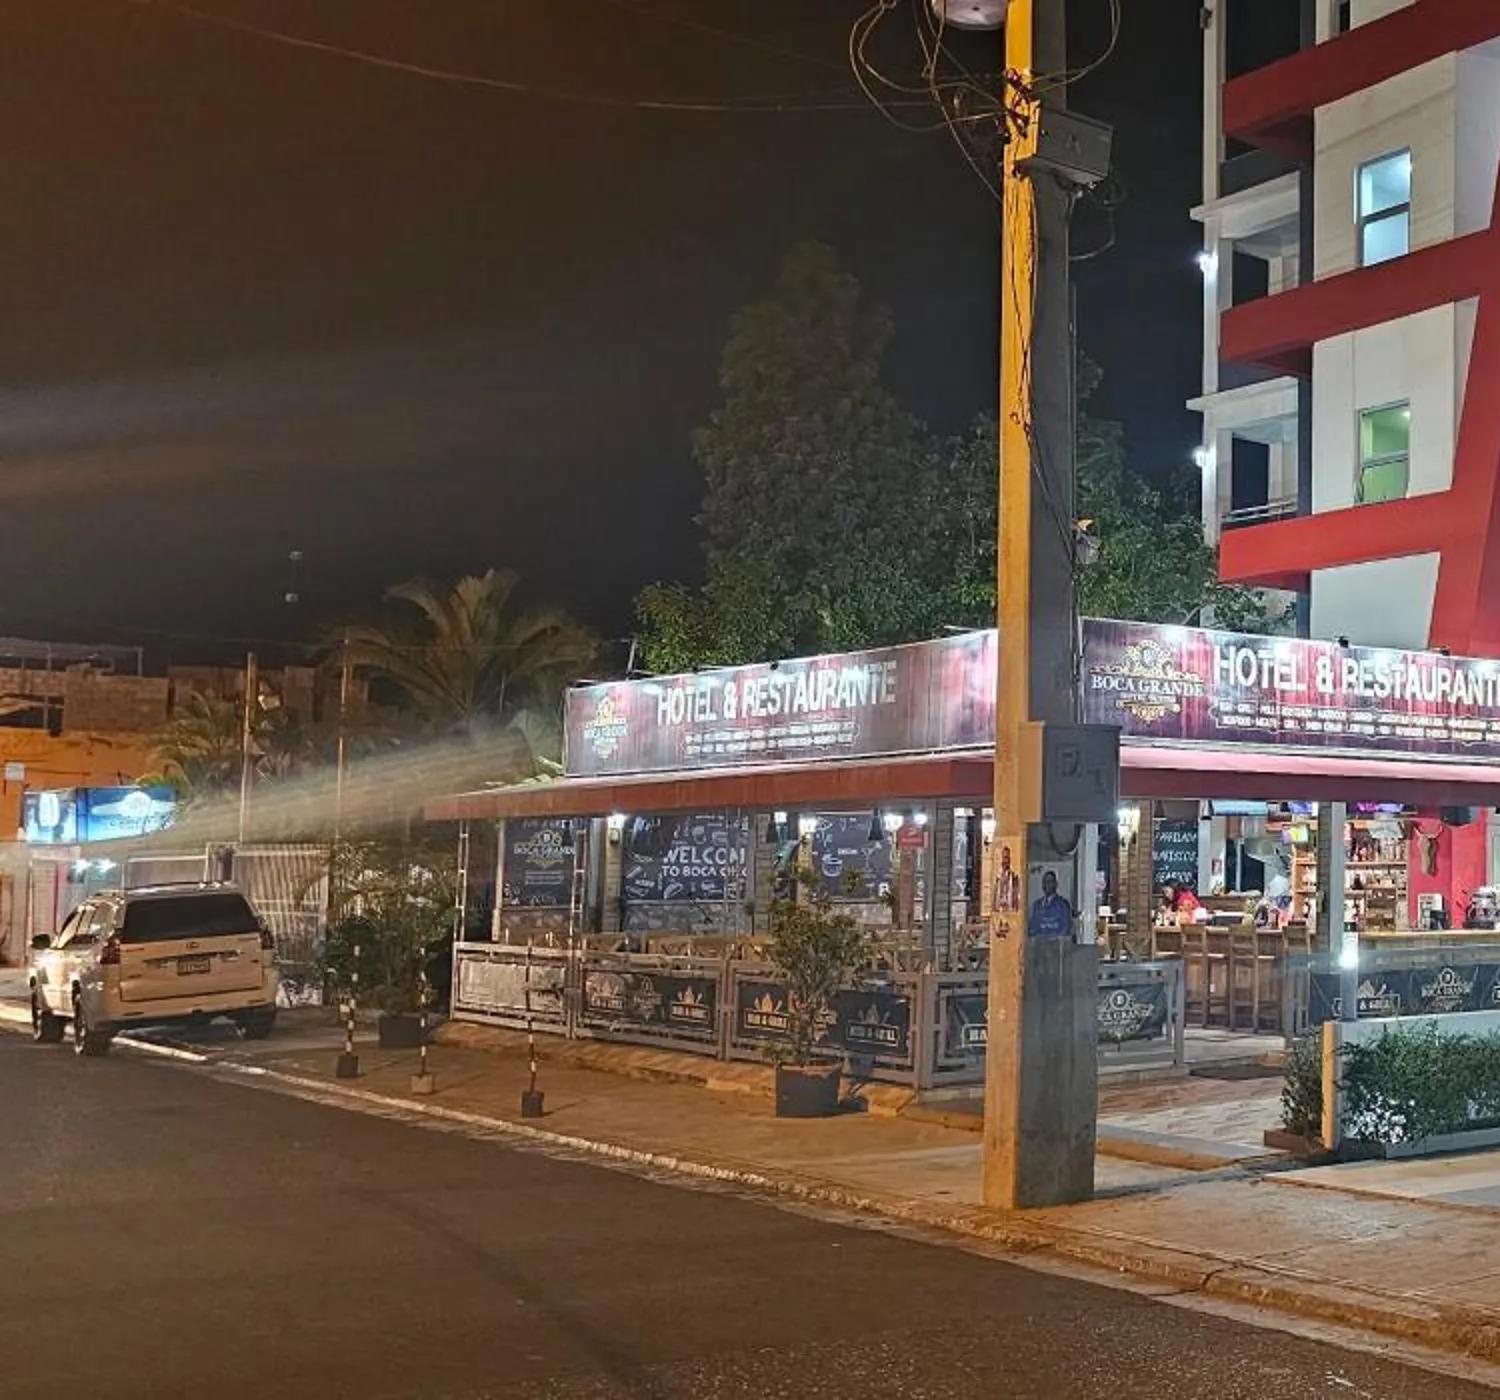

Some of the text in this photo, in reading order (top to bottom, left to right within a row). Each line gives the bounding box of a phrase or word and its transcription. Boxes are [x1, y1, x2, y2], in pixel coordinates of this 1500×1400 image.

[1214, 643, 1307, 692] HOTEL
[1316, 654, 1334, 694] &
[656, 660, 898, 726] HOTEL & RESTAURANTE
[1091, 674, 1136, 693] BOCA
[1139, 678, 1206, 697] GRANDE
[663, 846, 745, 865] WELCOM
[661, 865, 680, 877] TO
[682, 865, 717, 877] BOCA
[969, 1029, 988, 1041] BA
